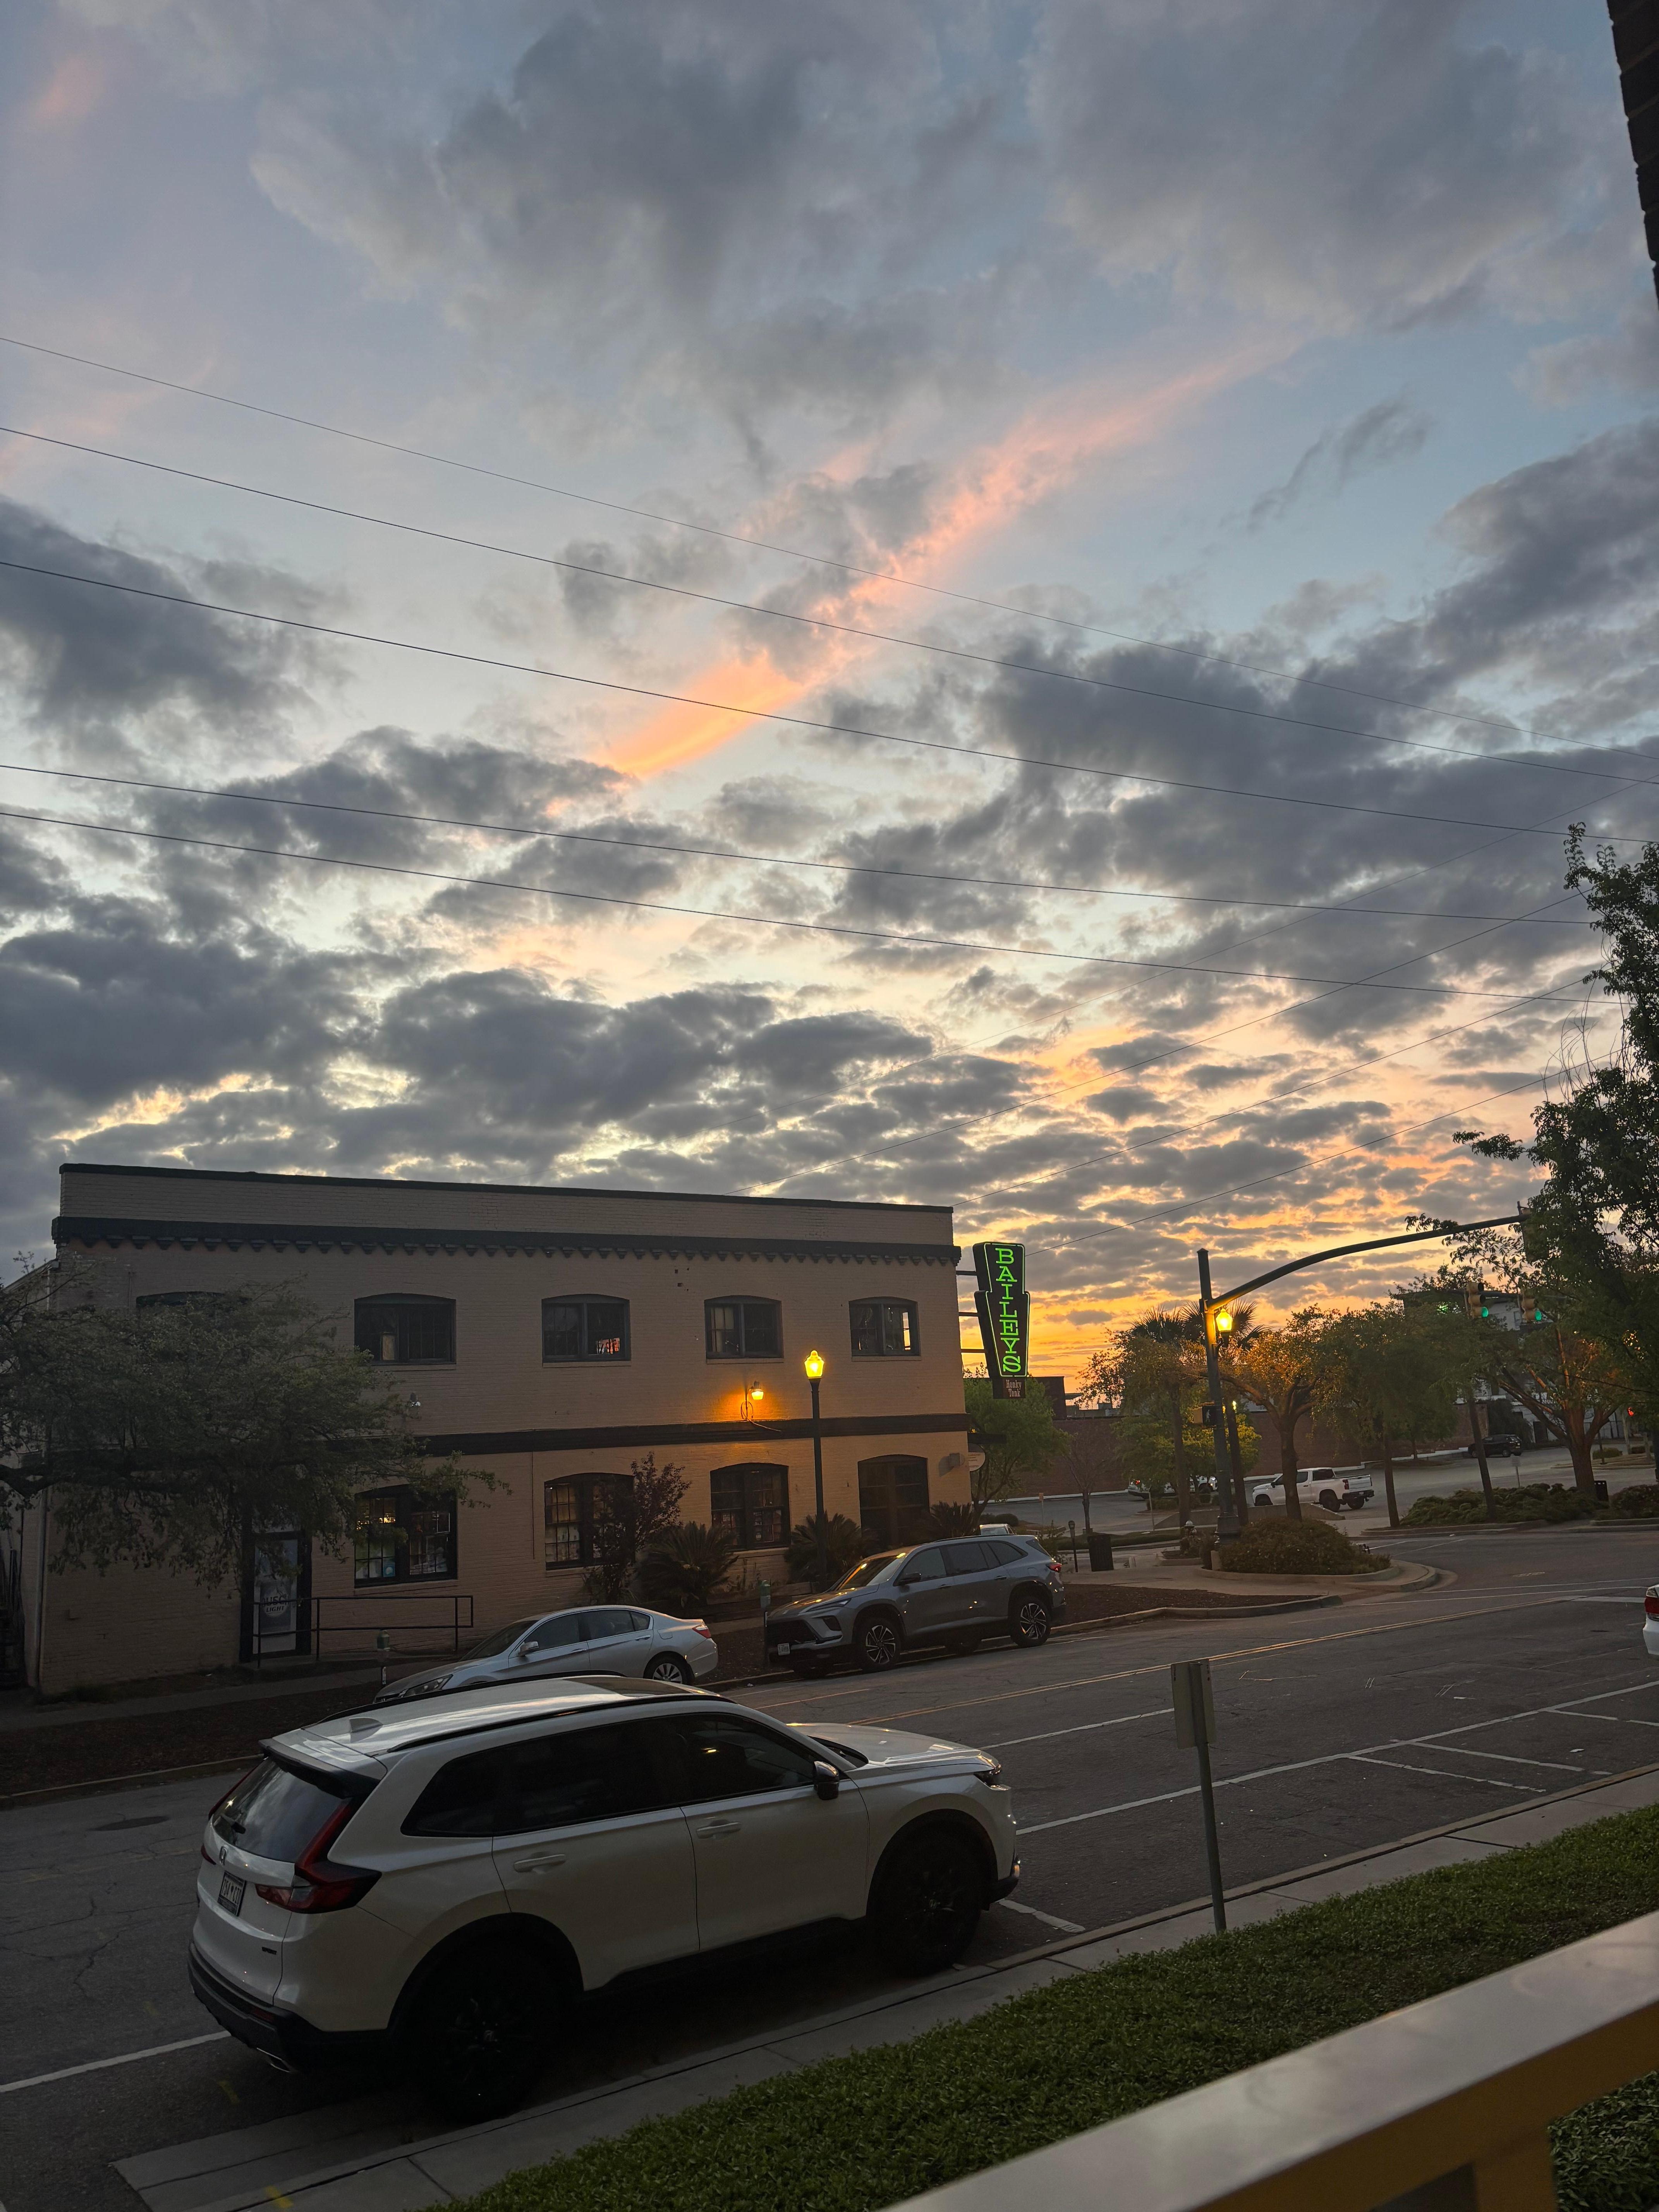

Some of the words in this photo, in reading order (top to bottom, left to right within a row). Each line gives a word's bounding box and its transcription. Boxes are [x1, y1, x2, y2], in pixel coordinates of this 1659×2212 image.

[995, 1247, 1021, 1373] BAILEYS
[1006, 1379, 1022, 1390] Honky
[1008, 1388, 1021, 1397] Tonk
